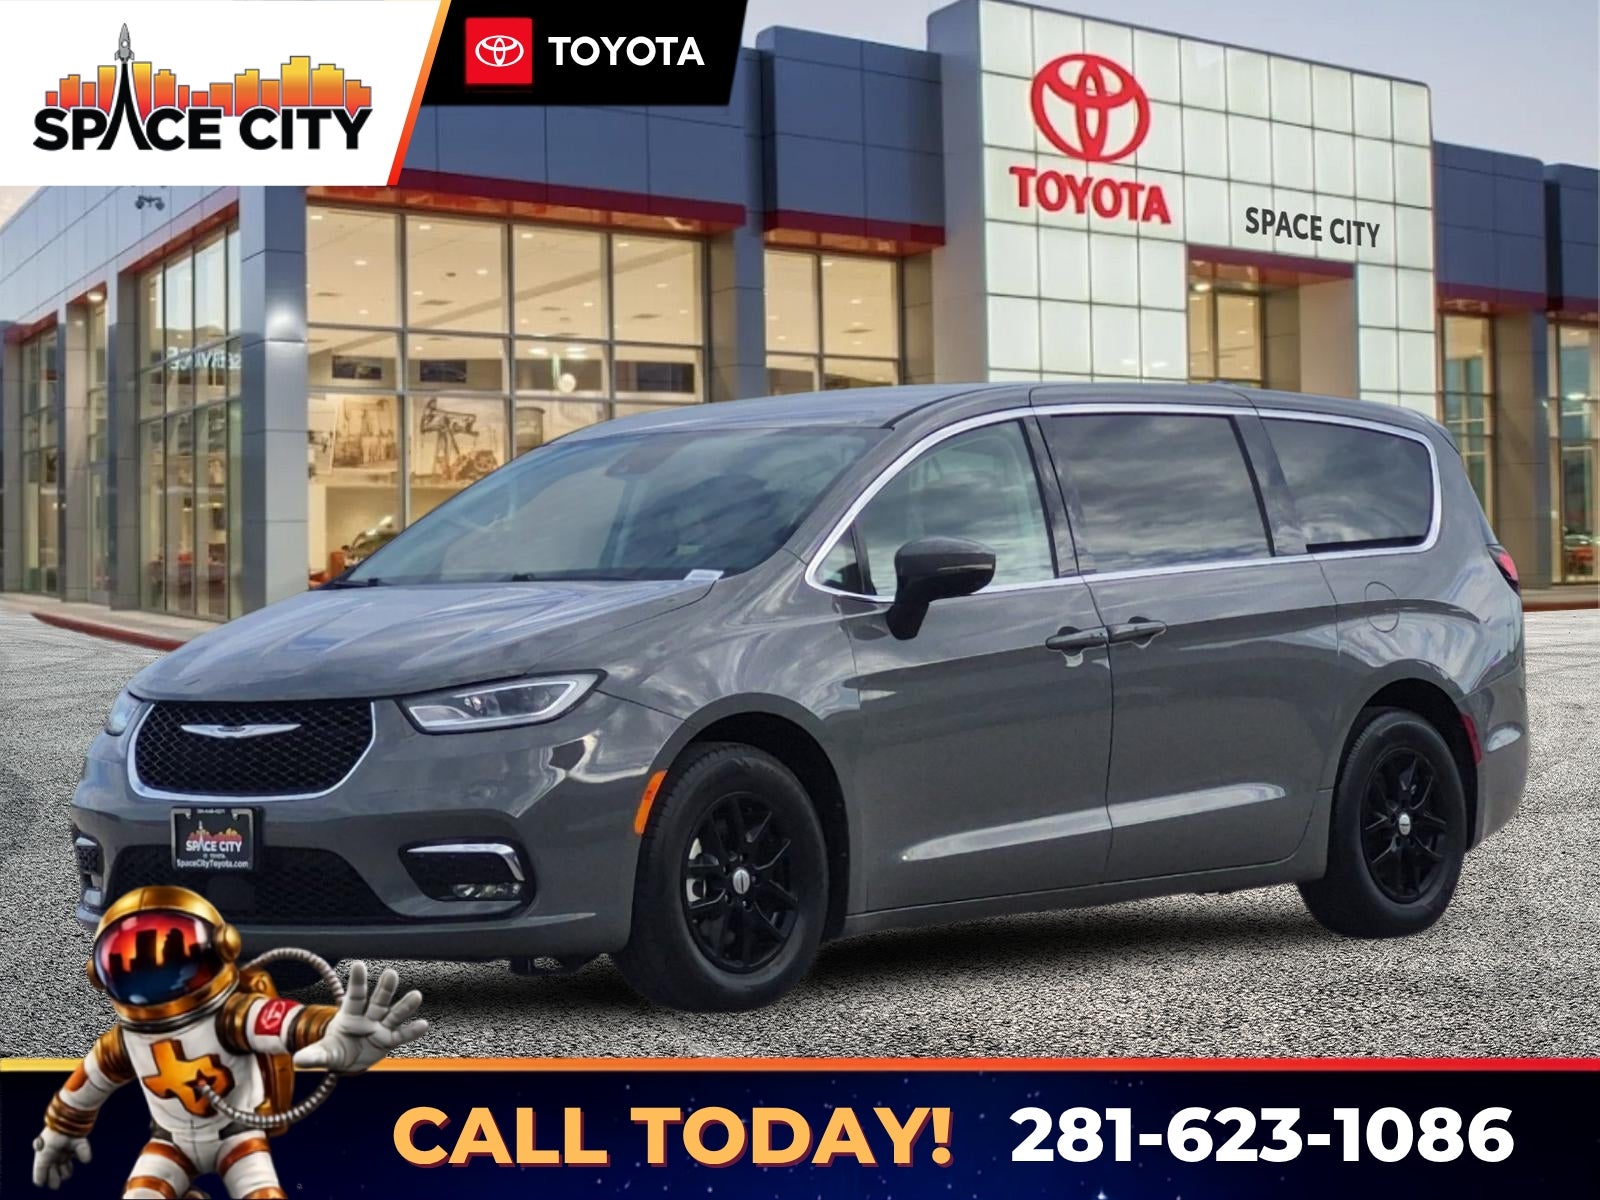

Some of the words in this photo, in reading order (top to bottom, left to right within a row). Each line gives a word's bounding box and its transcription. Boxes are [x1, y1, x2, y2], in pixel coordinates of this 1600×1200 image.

[1009, 166, 1171, 224] TOYOTA
[1245, 206, 1322, 242] SPACE
[1329, 218, 1381, 248] CITY
[185, 840, 217, 853] SPACE
[219, 840, 242, 853] CITY
